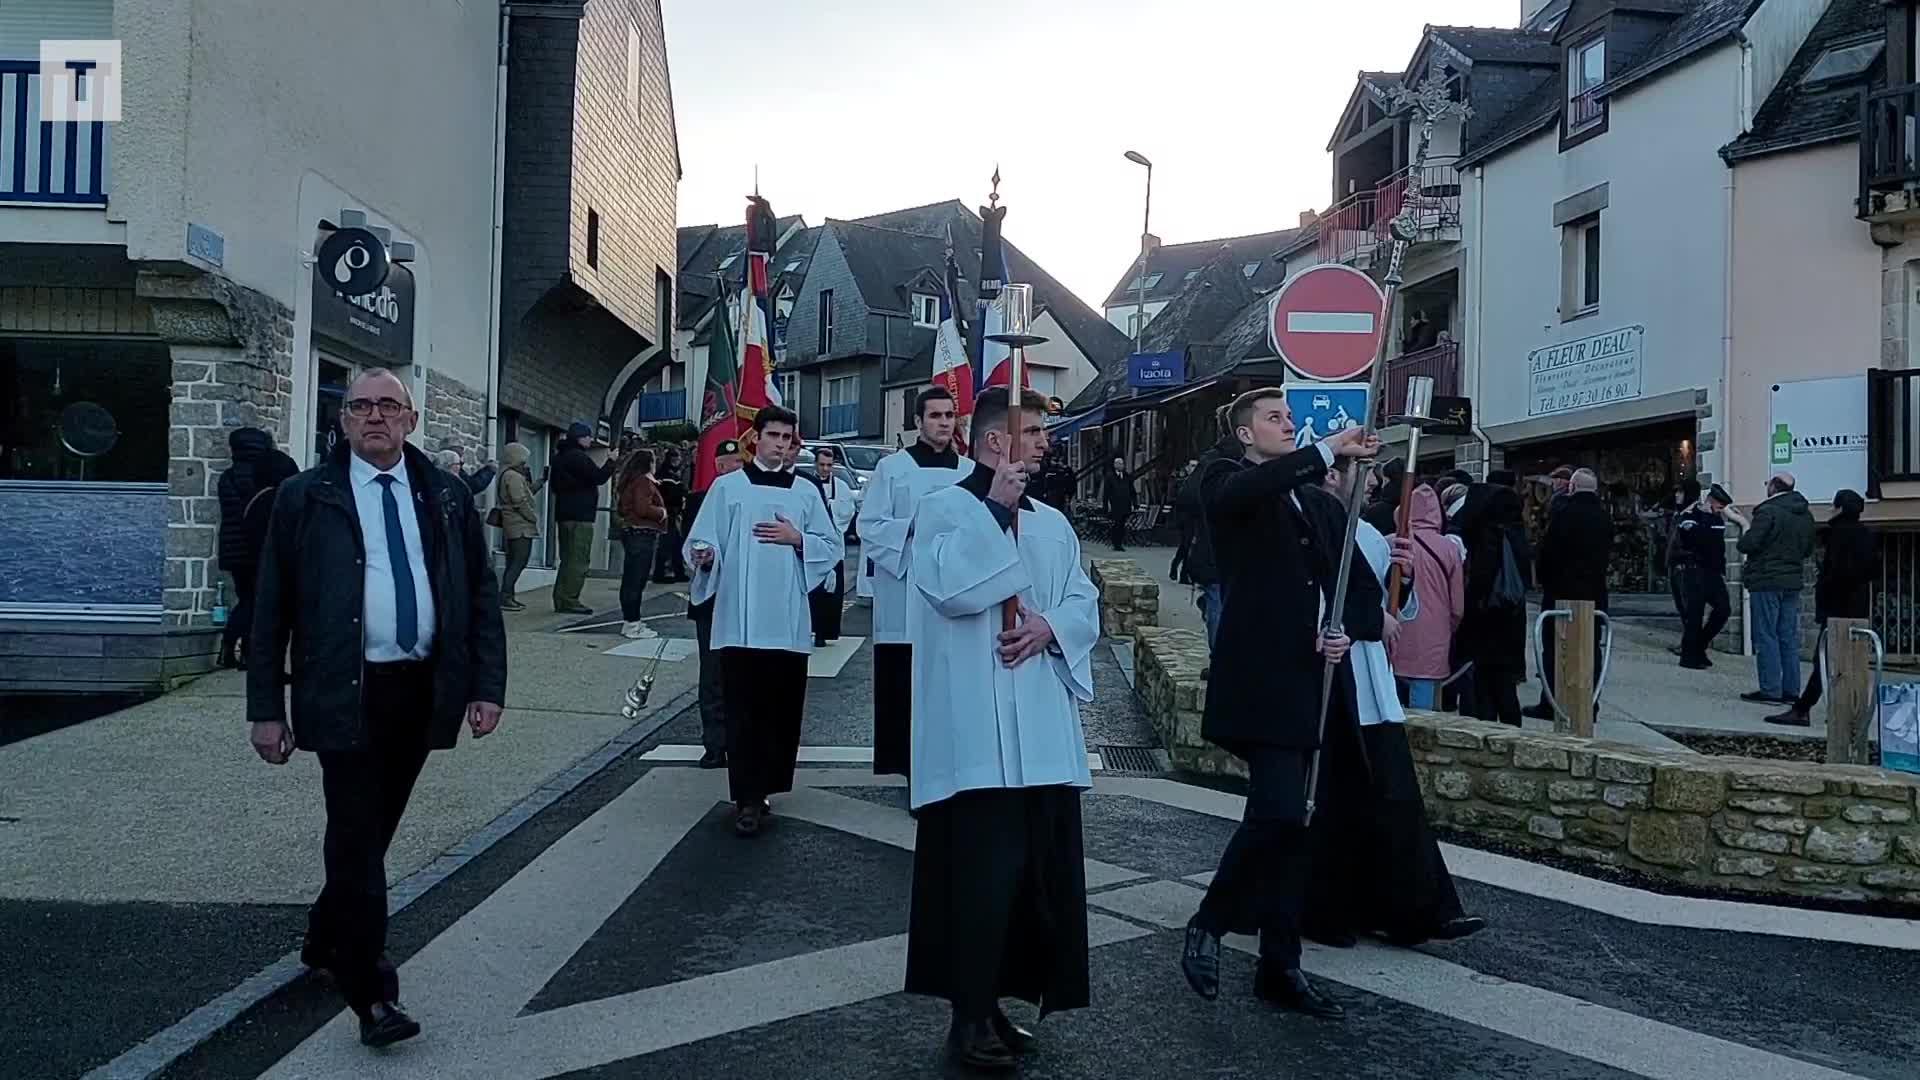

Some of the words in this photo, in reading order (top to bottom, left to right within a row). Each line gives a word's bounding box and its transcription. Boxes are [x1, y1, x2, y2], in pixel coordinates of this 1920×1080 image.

[1546, 343, 1586, 369] FLEUR
[1572, 391, 1584, 406] 97
[1585, 388, 1599, 403] 30
[1601, 385, 1612, 400] 16
[1615, 383, 1629, 397] 90
